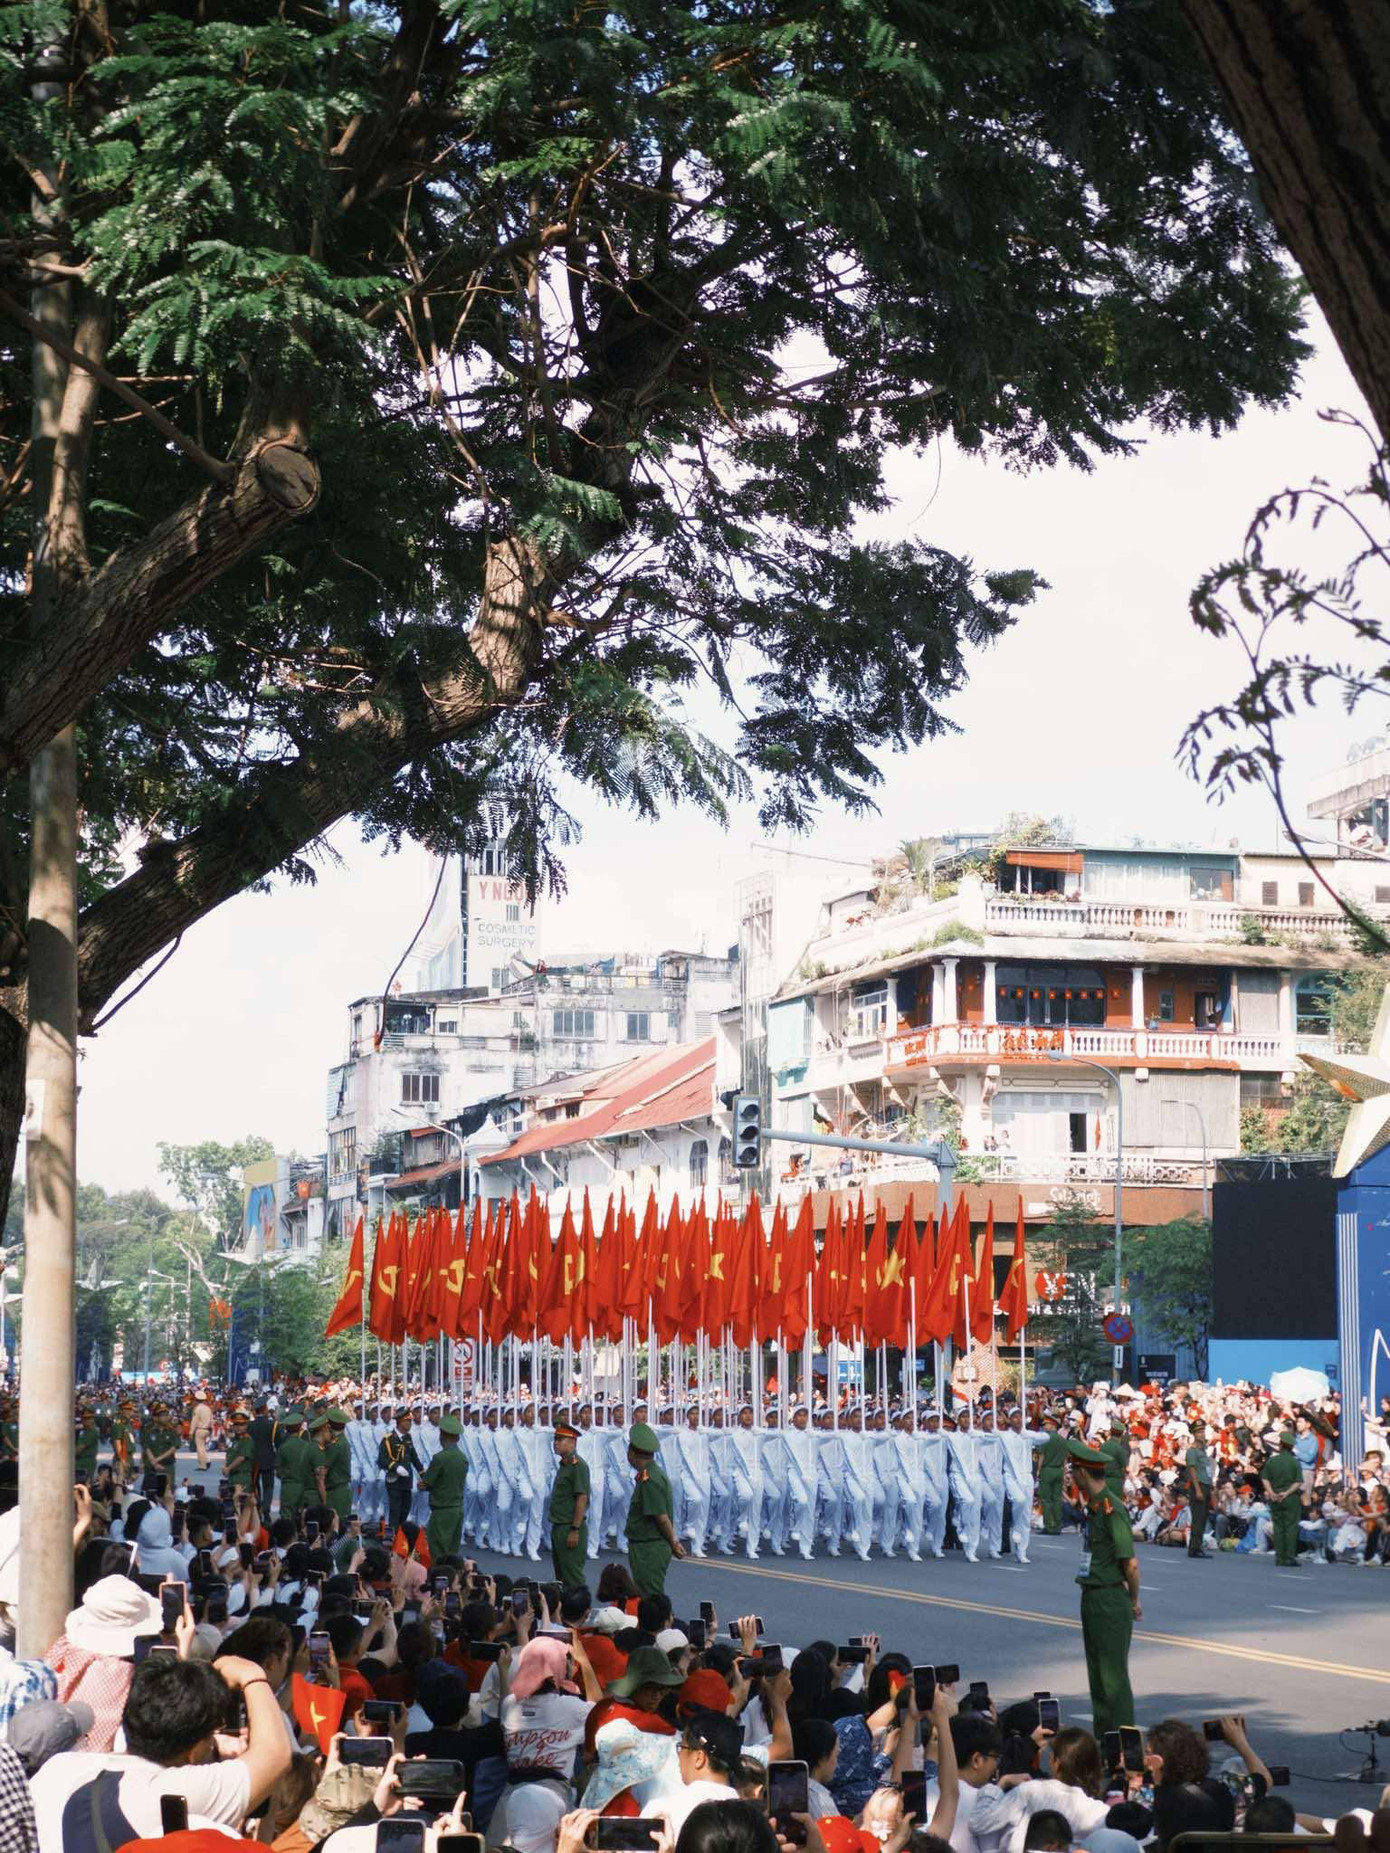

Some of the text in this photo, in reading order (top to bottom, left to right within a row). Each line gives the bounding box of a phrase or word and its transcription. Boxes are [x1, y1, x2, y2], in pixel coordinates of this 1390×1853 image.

[478, 922, 536, 935] COSMETIC
[477, 935, 535, 949] SURGERY
[1044, 1304, 1053, 1315] &
